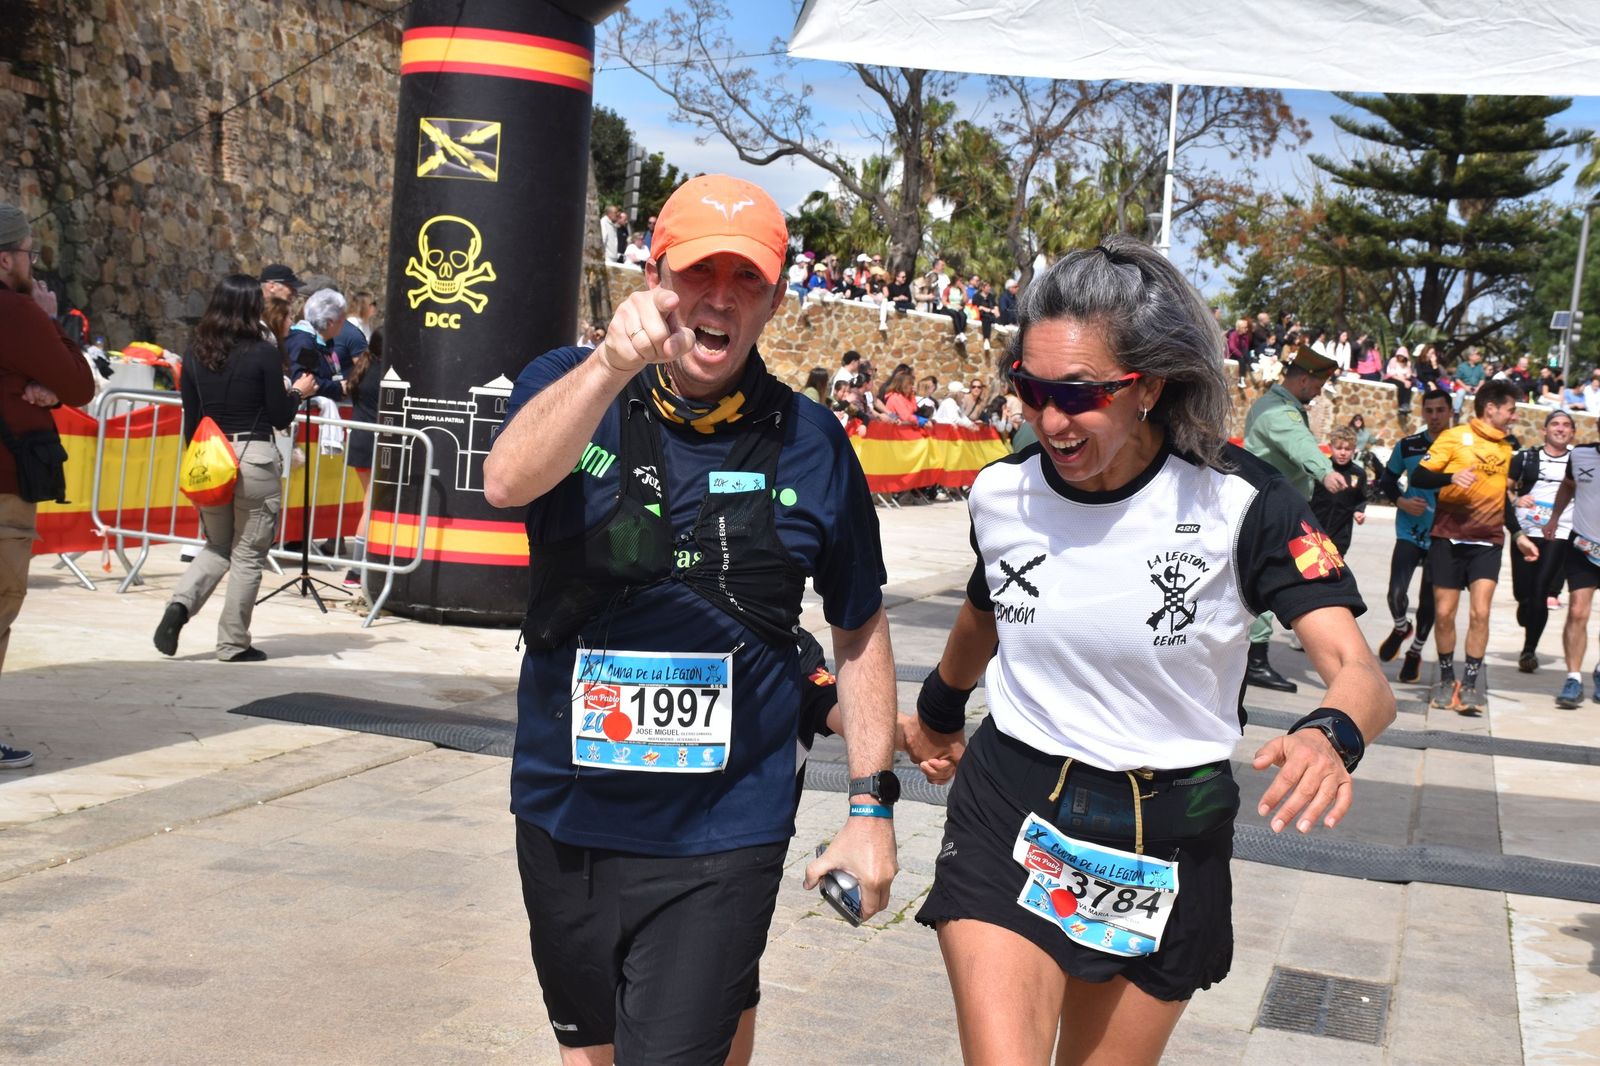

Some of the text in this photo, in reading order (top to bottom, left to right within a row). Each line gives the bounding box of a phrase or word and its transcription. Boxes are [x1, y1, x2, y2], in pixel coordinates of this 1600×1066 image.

[424, 312, 462, 329] DCC
[411, 413, 425, 421] TODO
[722, 553, 730, 570] OUR
[1147, 551, 1210, 573] LA LEGIÓN
[1153, 634, 1187, 646] CEUTA
[584, 692, 620, 703] San Pablo
[630, 687, 721, 728] 1997
[635, 728, 653, 736] JOSE
[654, 728, 680, 737] MIGUEL
[1026, 851, 1062, 872] San Pablo
[1066, 871, 1162, 919] 3784
[1087, 906, 1110, 918] MARIA
